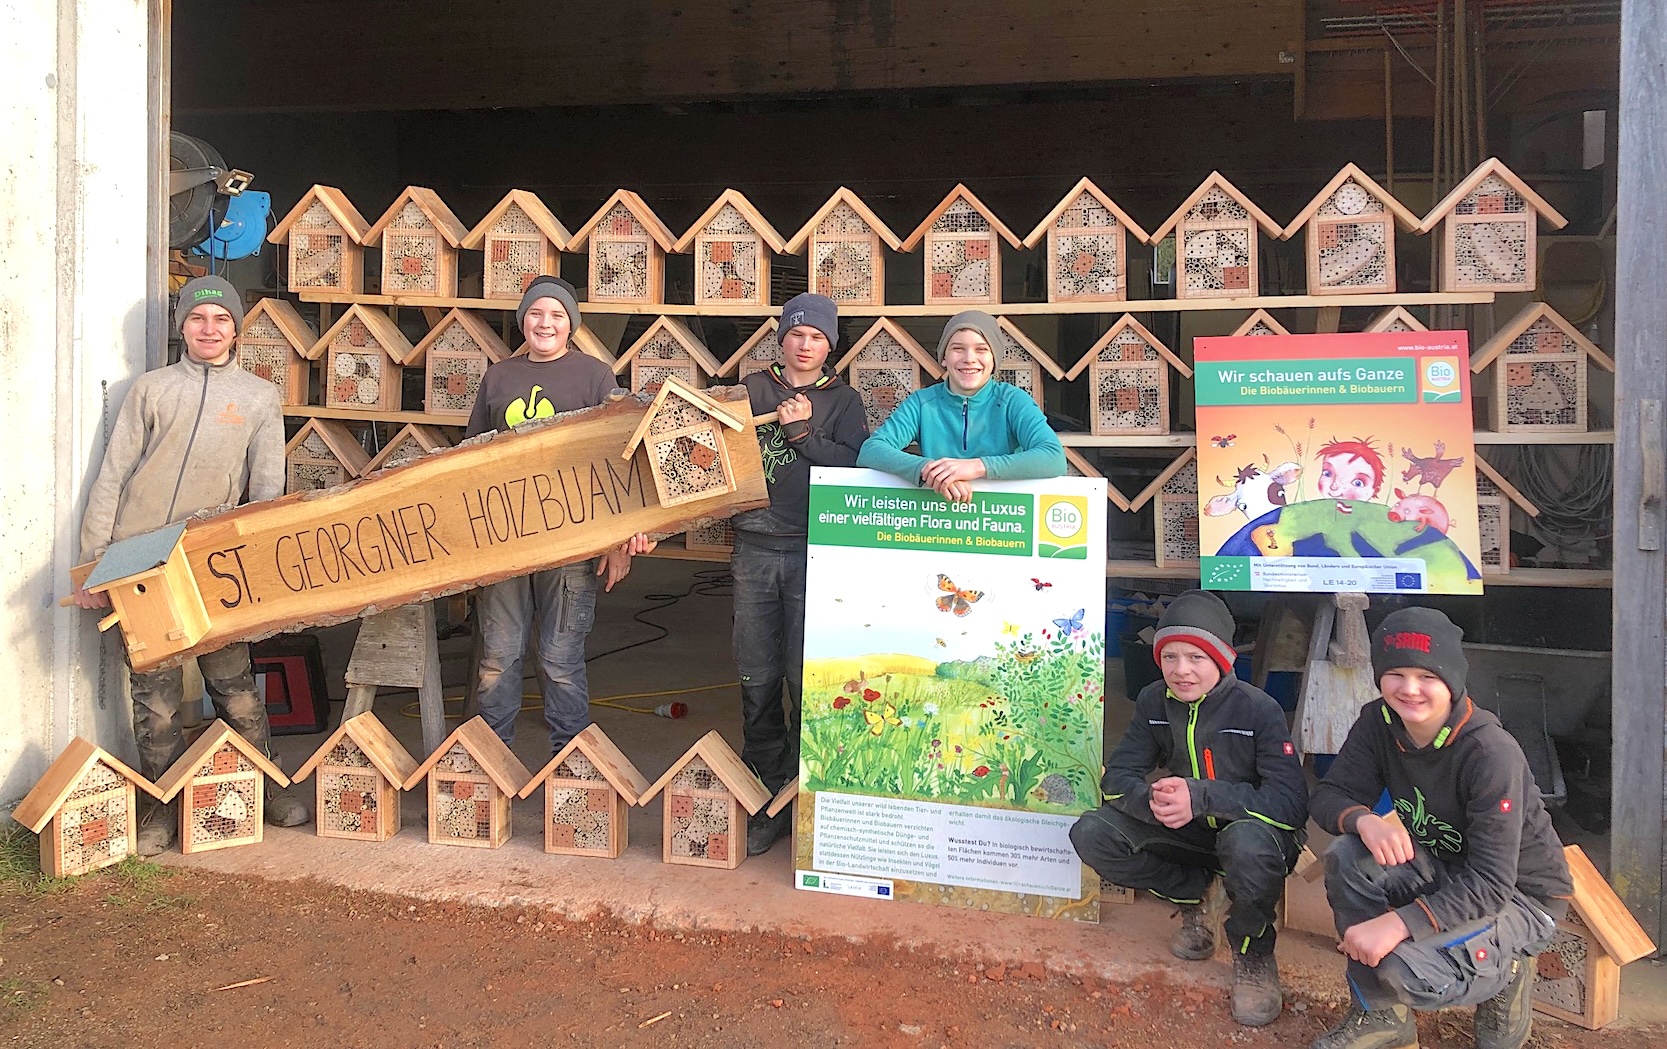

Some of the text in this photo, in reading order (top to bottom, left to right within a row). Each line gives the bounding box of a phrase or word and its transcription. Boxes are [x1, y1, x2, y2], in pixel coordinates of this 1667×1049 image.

[1218, 367, 1404, 383] Wir schauen aufs Ganze
[1431, 365, 1451, 376] Bio
[1241, 384, 1405, 395] Die Biobäuerinnen & Biobauern
[844, 493, 1026, 515] Wir leisten uns den Luxus
[819, 510, 1025, 533] einer vielfältigen Flora und Fauna.
[1052, 508, 1076, 523] Bio
[877, 531, 1025, 548] Die Biobäuerinnen & Biobauern
[207, 544, 261, 609] ST.
[275, 502, 450, 592] GEORGNER
[820, 805, 857, 815] Pflanzenwelt
[831, 797, 851, 806] Vielfalt
[888, 804, 914, 812] lebenden
[820, 814, 860, 824] Biobäuerinnen
[874, 820, 903, 829] Biobauern
[904, 824, 934, 832] verzichten
[975, 812, 991, 820] damit
[1004, 816, 1040, 824] ökologische
[819, 831, 878, 844] Pflanzenschutzmittel
[890, 840, 917, 848] schützen
[947, 836, 977, 846] Wusstest
[978, 839, 991, 847] Du?
[999, 842, 1030, 851] biologisch
[819, 841, 846, 849] natürliche
[877, 847, 896, 855] leisten
[958, 846, 982, 855] Flächen
[983, 849, 1009, 858] kommen
[1040, 855, 1057, 863] Arten
[819, 850, 850, 859] stattdessen
[850, 853, 876, 863] Nützlinge
[888, 857, 912, 866] Insekten
[924, 861, 941, 870] Vögel
[836, 860, 890, 873] Bio-Landwirtschaft
[890, 867, 925, 876] einzusetzen
[947, 854, 959, 862] 50%
[976, 858, 1007, 867] Individuen
